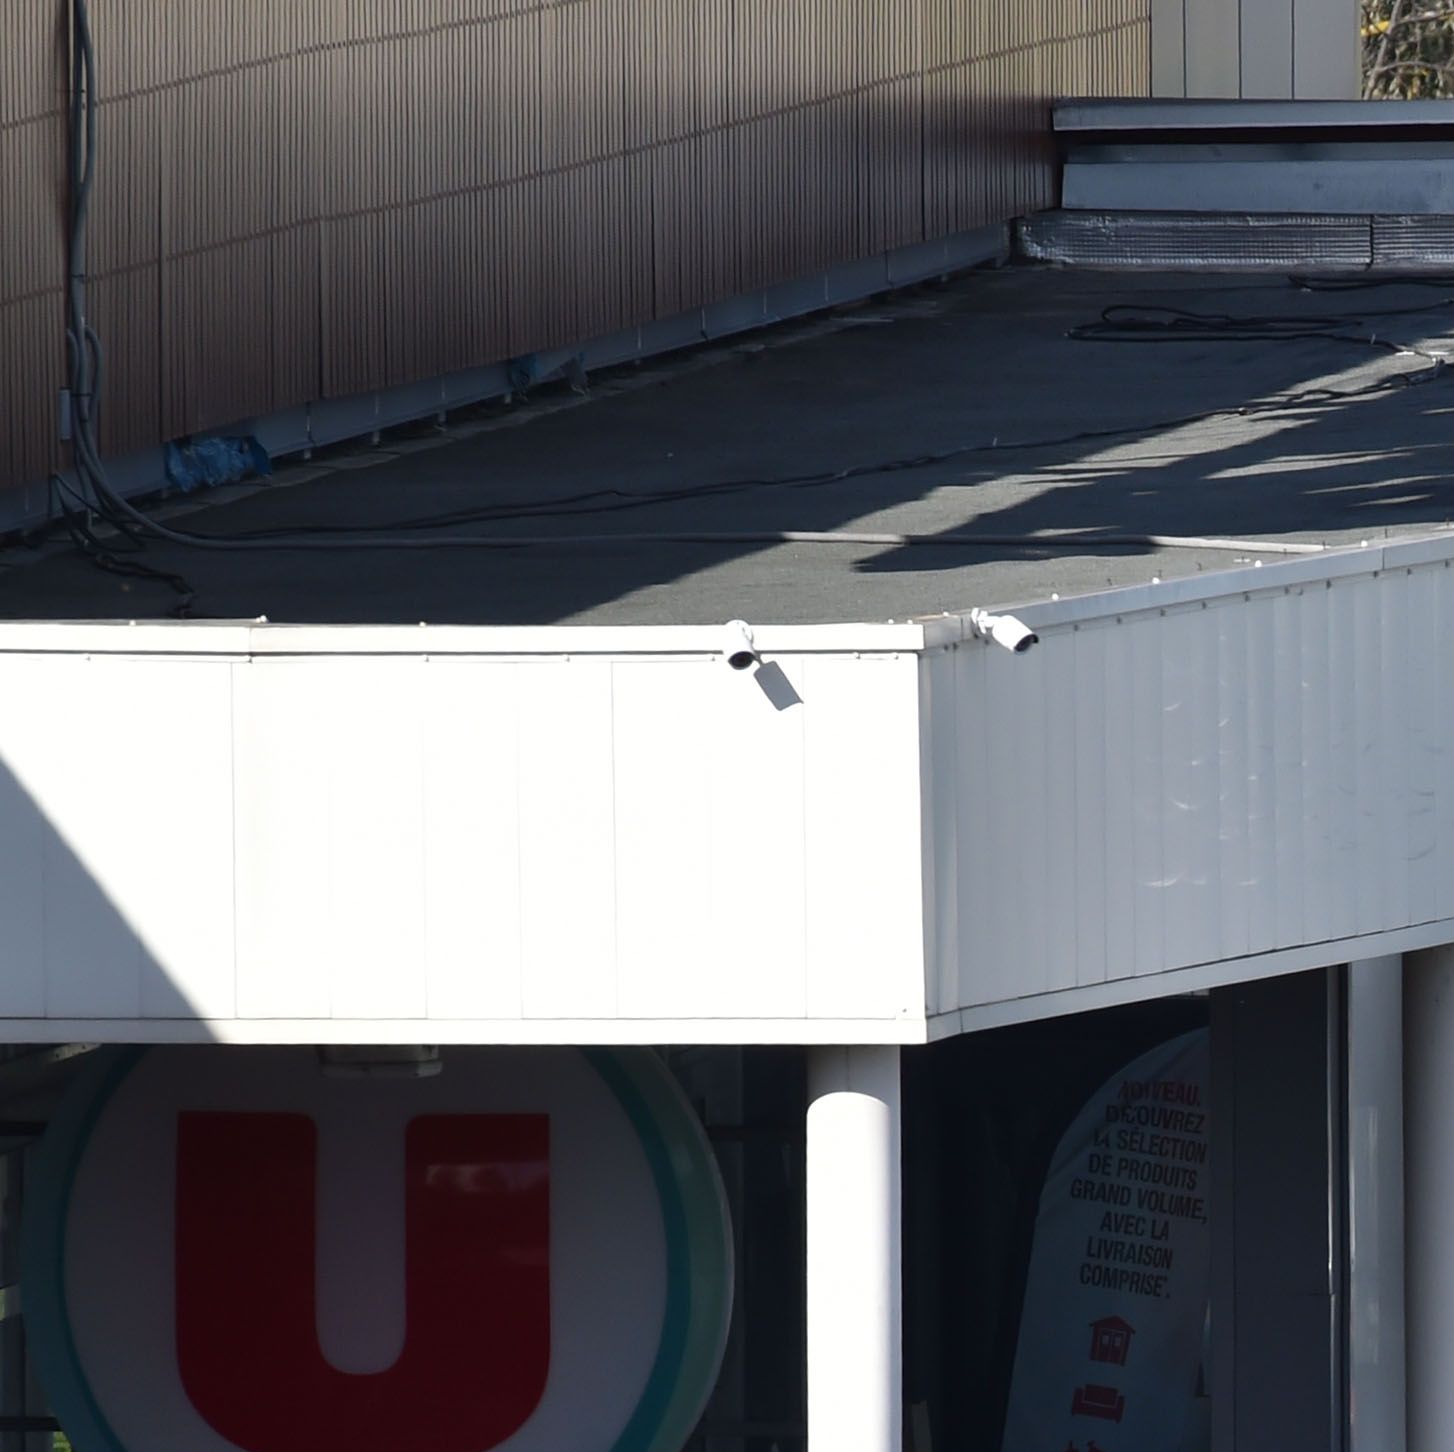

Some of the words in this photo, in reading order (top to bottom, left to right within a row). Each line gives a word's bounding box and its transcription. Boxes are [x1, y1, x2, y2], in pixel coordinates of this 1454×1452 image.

[1116, 1126, 1208, 1164] SÉLECTION
[1088, 1153, 1113, 1177] DE
[1117, 1157, 1198, 1191] PRODUITS
[1070, 1179, 1132, 1207] GRAND
[1100, 1211, 1146, 1238] AVEC
[1151, 1219, 1170, 1241] LA
[1086, 1236, 1173, 1270] LIVRAISON
